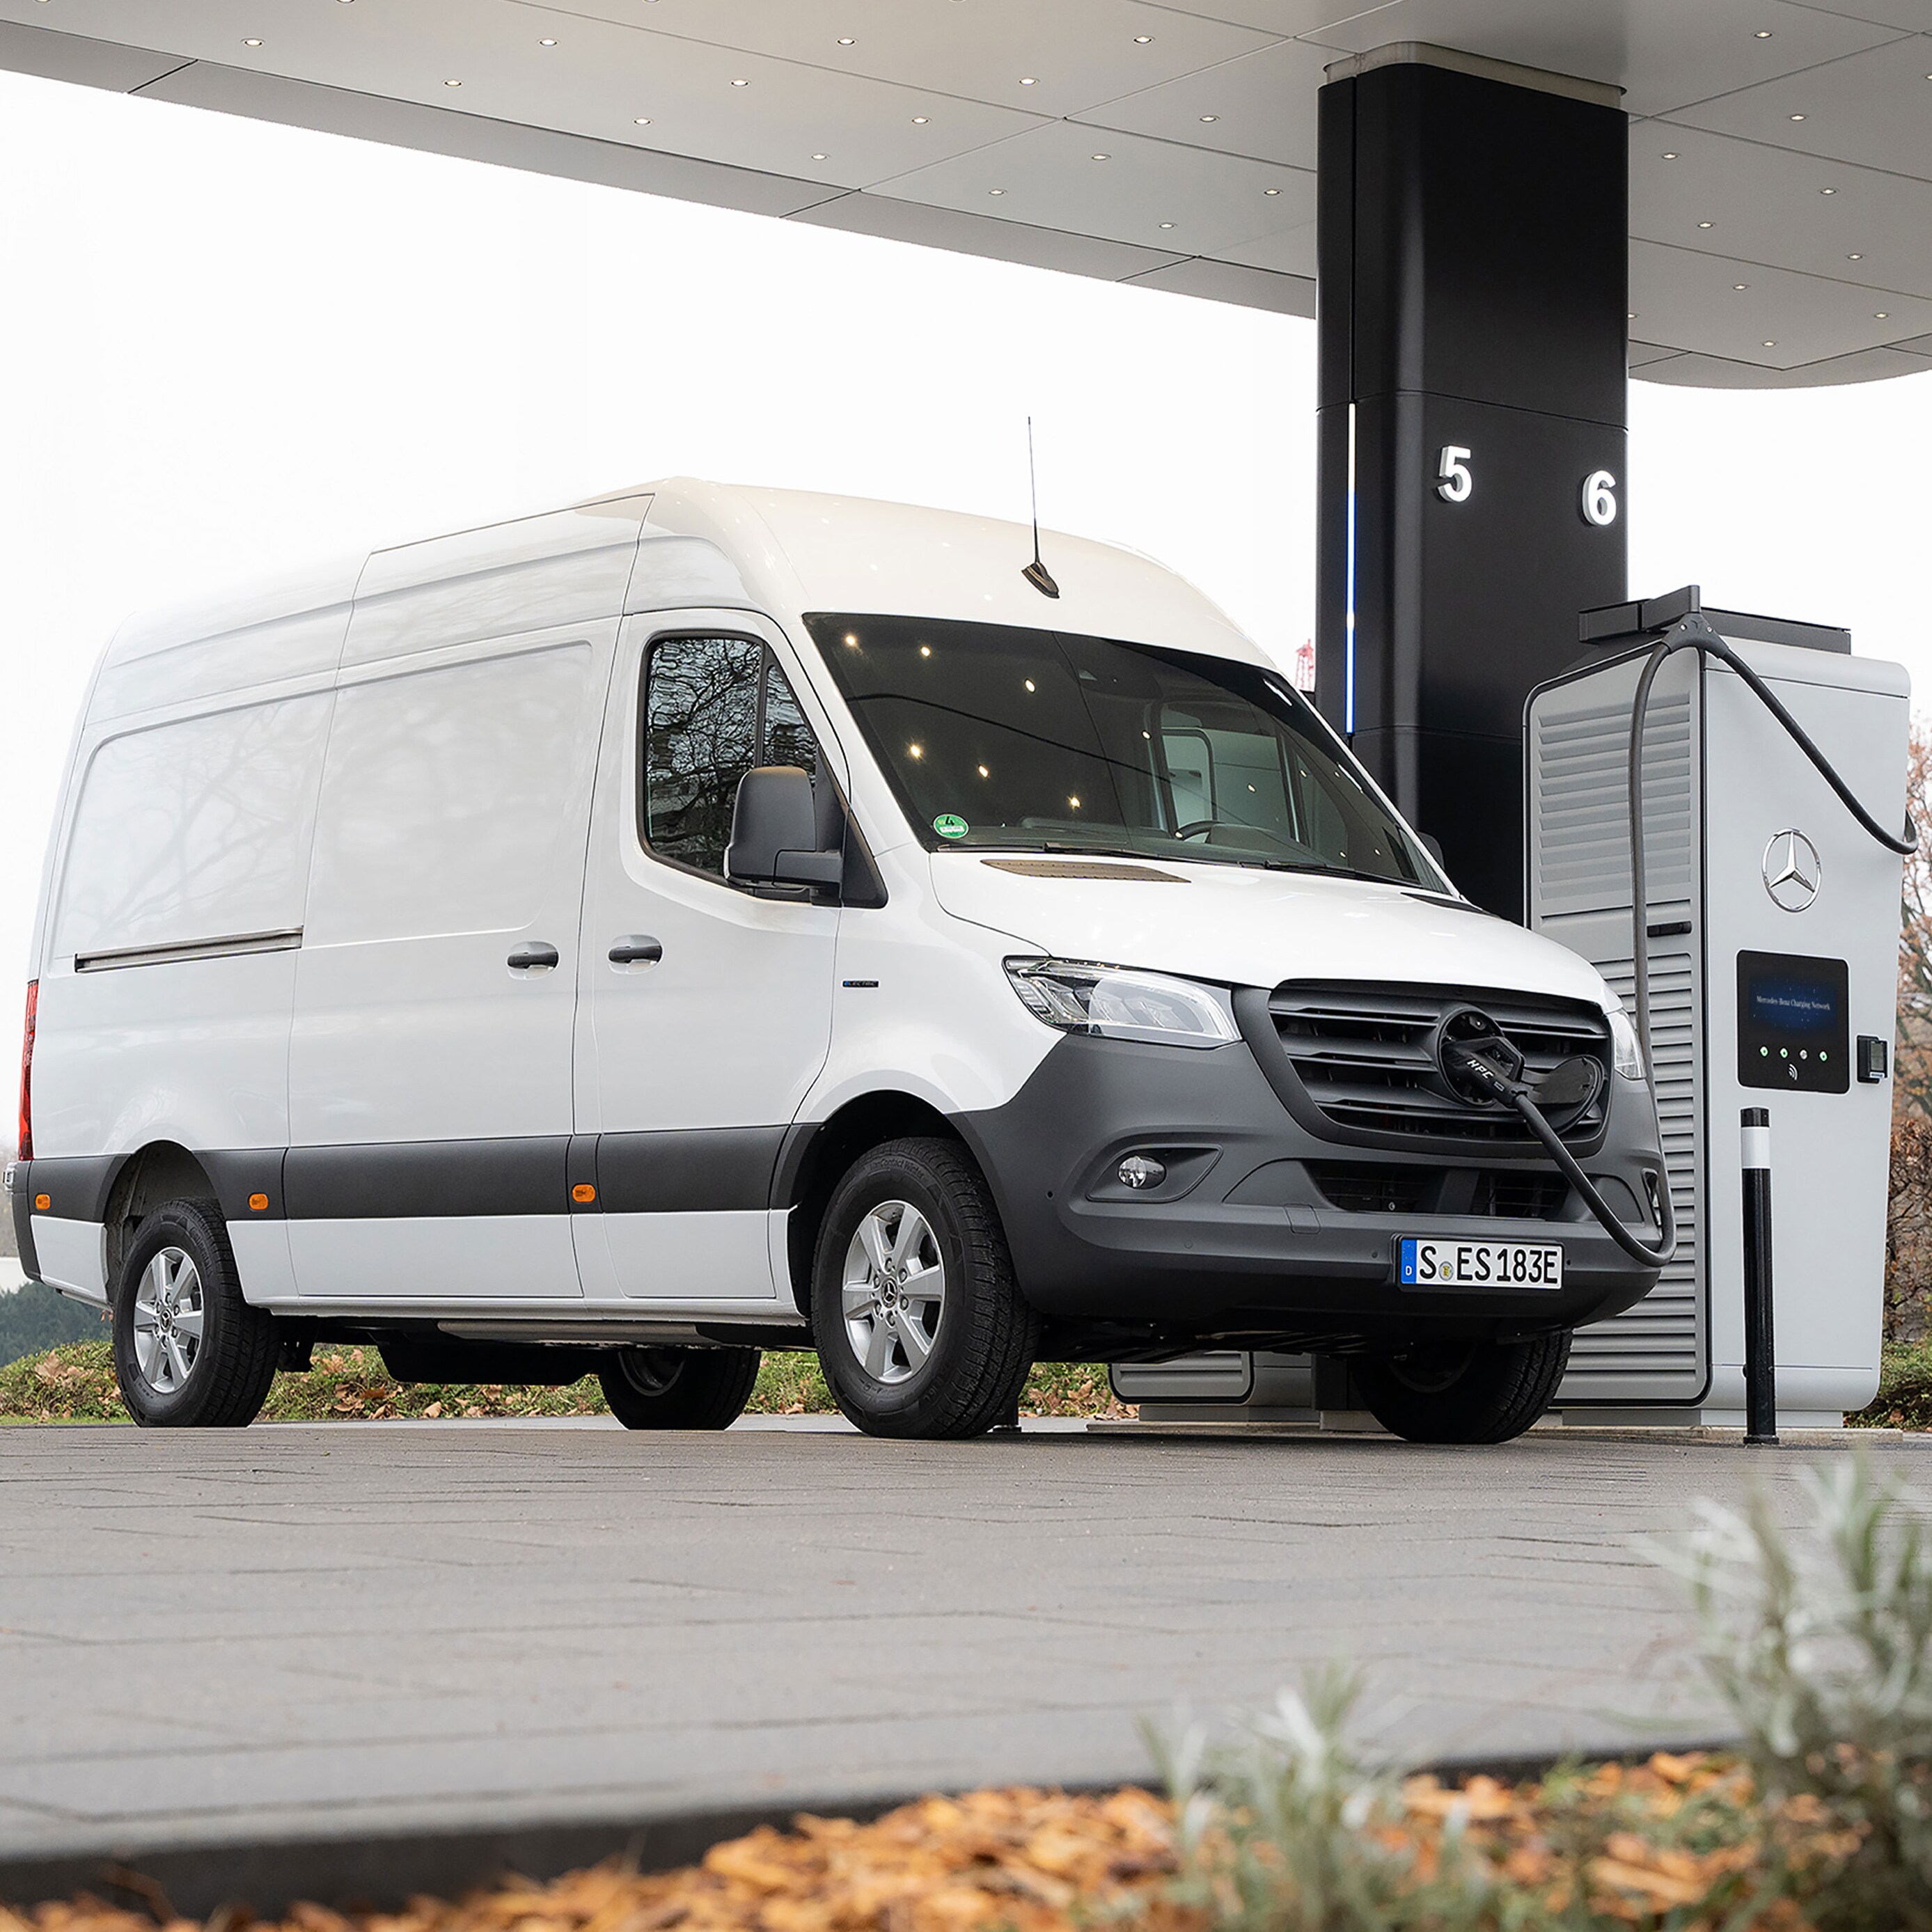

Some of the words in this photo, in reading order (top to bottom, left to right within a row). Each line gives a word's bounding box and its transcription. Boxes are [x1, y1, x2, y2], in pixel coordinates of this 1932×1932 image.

[1437, 446, 1472, 502] 5
[1582, 470, 1617, 526] 6
[945, 816, 955, 826] 4
[1791, 998, 1811, 1010] Charging
[1812, 1001, 1830, 1011] Network
[1467, 1060, 1494, 1078] HPC
[1406, 1266, 1412, 1275] D
[1419, 1246, 1437, 1279] S
